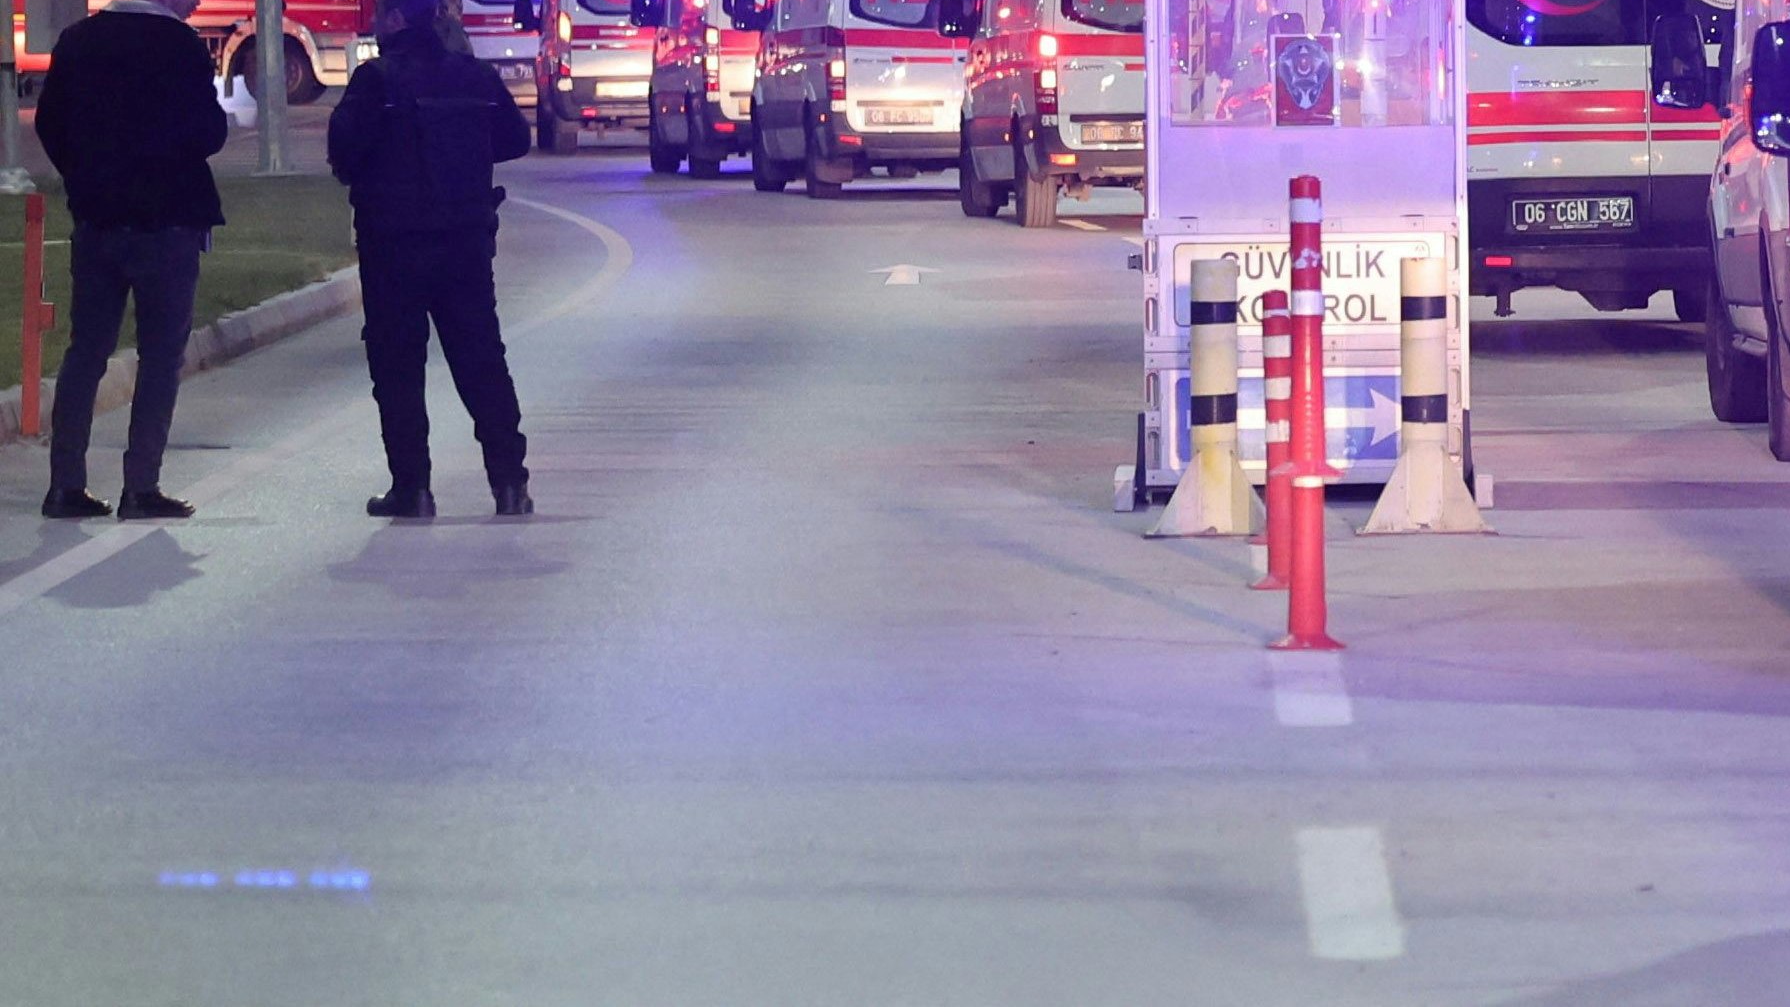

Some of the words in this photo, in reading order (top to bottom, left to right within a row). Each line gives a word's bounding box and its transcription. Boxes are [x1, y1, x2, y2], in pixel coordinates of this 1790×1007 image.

[1525, 204, 1545, 223] 06
[1556, 200, 1588, 222] CGN
[1600, 199, 1630, 221] 567
[1236, 294, 1387, 324] KOROL
